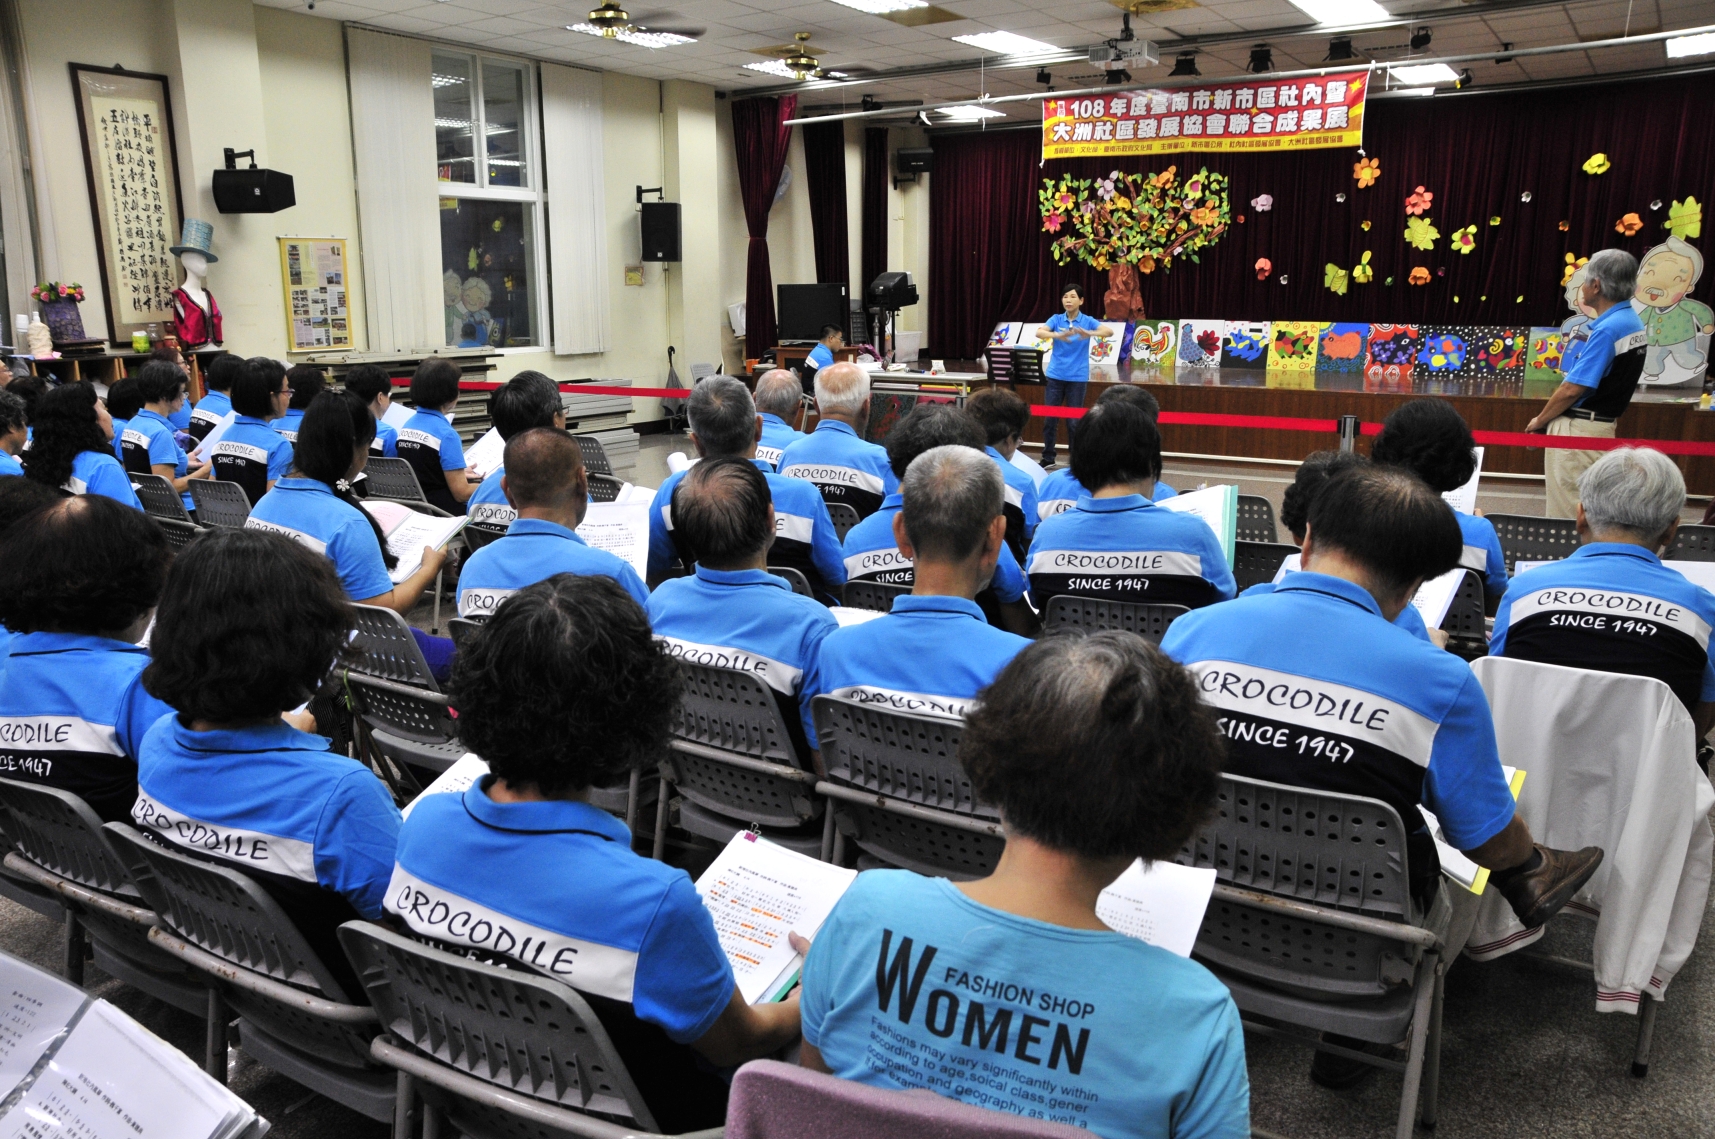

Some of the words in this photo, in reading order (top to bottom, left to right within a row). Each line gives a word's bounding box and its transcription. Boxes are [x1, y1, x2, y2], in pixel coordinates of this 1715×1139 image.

[1053, 106, 1349, 142] 大洲社區發展協會聯合成果展
[788, 467, 858, 484] CROCODILE
[824, 485, 846, 496] 1947
[476, 507, 517, 522] CROCOD
[1055, 554, 1163, 570] CROCODILE
[1068, 578, 1112, 590] SINCE
[1115, 578, 1149, 591] 1947
[1537, 591, 1681, 622] CROCODILE
[1549, 614, 1606, 629] SINCE
[1612, 620, 1658, 636] 1947
[1200, 671, 1390, 731] CROCODILE
[0, 723, 72, 744] CODILE
[1215, 717, 1290, 748] SINCE
[1295, 735, 1355, 764] 1947
[19, 757, 52, 777] 1947
[133, 798, 269, 860] CROCODILE
[396, 885, 579, 975] CROCODILE
[876, 928, 1091, 1076] WOMEN
[944, 966, 1034, 1007] FASHION
[1038, 993, 1095, 1020] SHOP
[870, 1031, 919, 1067] according
[923, 1058, 935, 1070] to
[871, 1016, 916, 1049] Fashions
[920, 1043, 946, 1061] may
[950, 1054, 978, 1070] vary
[982, 1060, 1057, 1095] significantly
[1061, 1085, 1099, 1102] within
[867, 1044, 923, 1081] occupation
[927, 1074, 952, 1090] and
[955, 1083, 1025, 1116] geography
[1028, 1107, 1044, 1120] as
